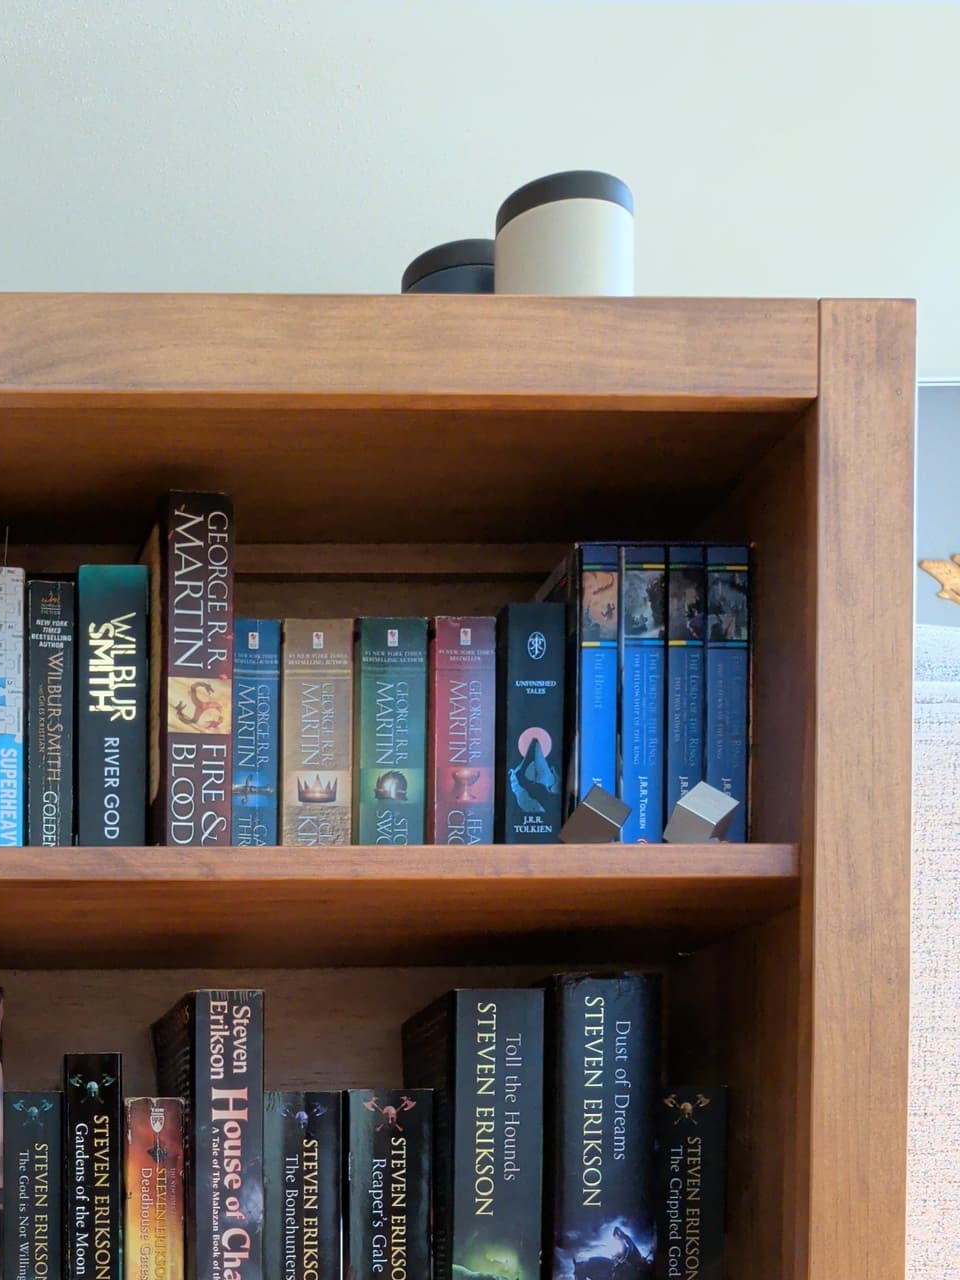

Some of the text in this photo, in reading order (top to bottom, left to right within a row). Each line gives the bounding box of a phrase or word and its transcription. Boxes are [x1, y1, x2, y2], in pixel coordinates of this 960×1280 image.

[174, 509, 204, 669] MARTIN
[515, 680, 556, 688] UNFINISHED
[47, 652, 63, 781] WILBUR SMITH
[238, 684, 256, 768] MARTIN
[301, 683, 321, 766] MARTIN
[376, 681, 394, 765] MARTIN
[104, 737, 120, 840] RIVER GOD
[171, 743, 197, 844] BLOOD
[201, 744, 226, 846] FIRE &
[639, 776, 648, 830] J.R.R. TOLKIEN
[514, 825, 552, 833] TOLKIEN
[523, 816, 544, 824] J.R.R.
[209, 1000, 230, 1079] Erikson
[232, 1005, 251, 1073] Steven
[504, 1033, 522, 1181] Toll the Hounds
[613, 1021, 631, 1160] Dust of Dreams
[19, 1150, 29, 1172] The
[211, 1087, 248, 1190] House
[212, 1137, 220, 1156] Tale
[212, 1158, 220, 1168] of
[19, 1175, 29, 1199] God
[35, 1144, 48, 1207] STEVEN
[212, 1171, 220, 1188] The
[18, 1216, 29, 1234] Not
[19, 1203, 28, 1211] is
[212, 1190, 220, 1232] Malazan
[225, 1198, 245, 1220] of
[212, 1234, 220, 1258] Book
[212, 1260, 220, 1271] of
